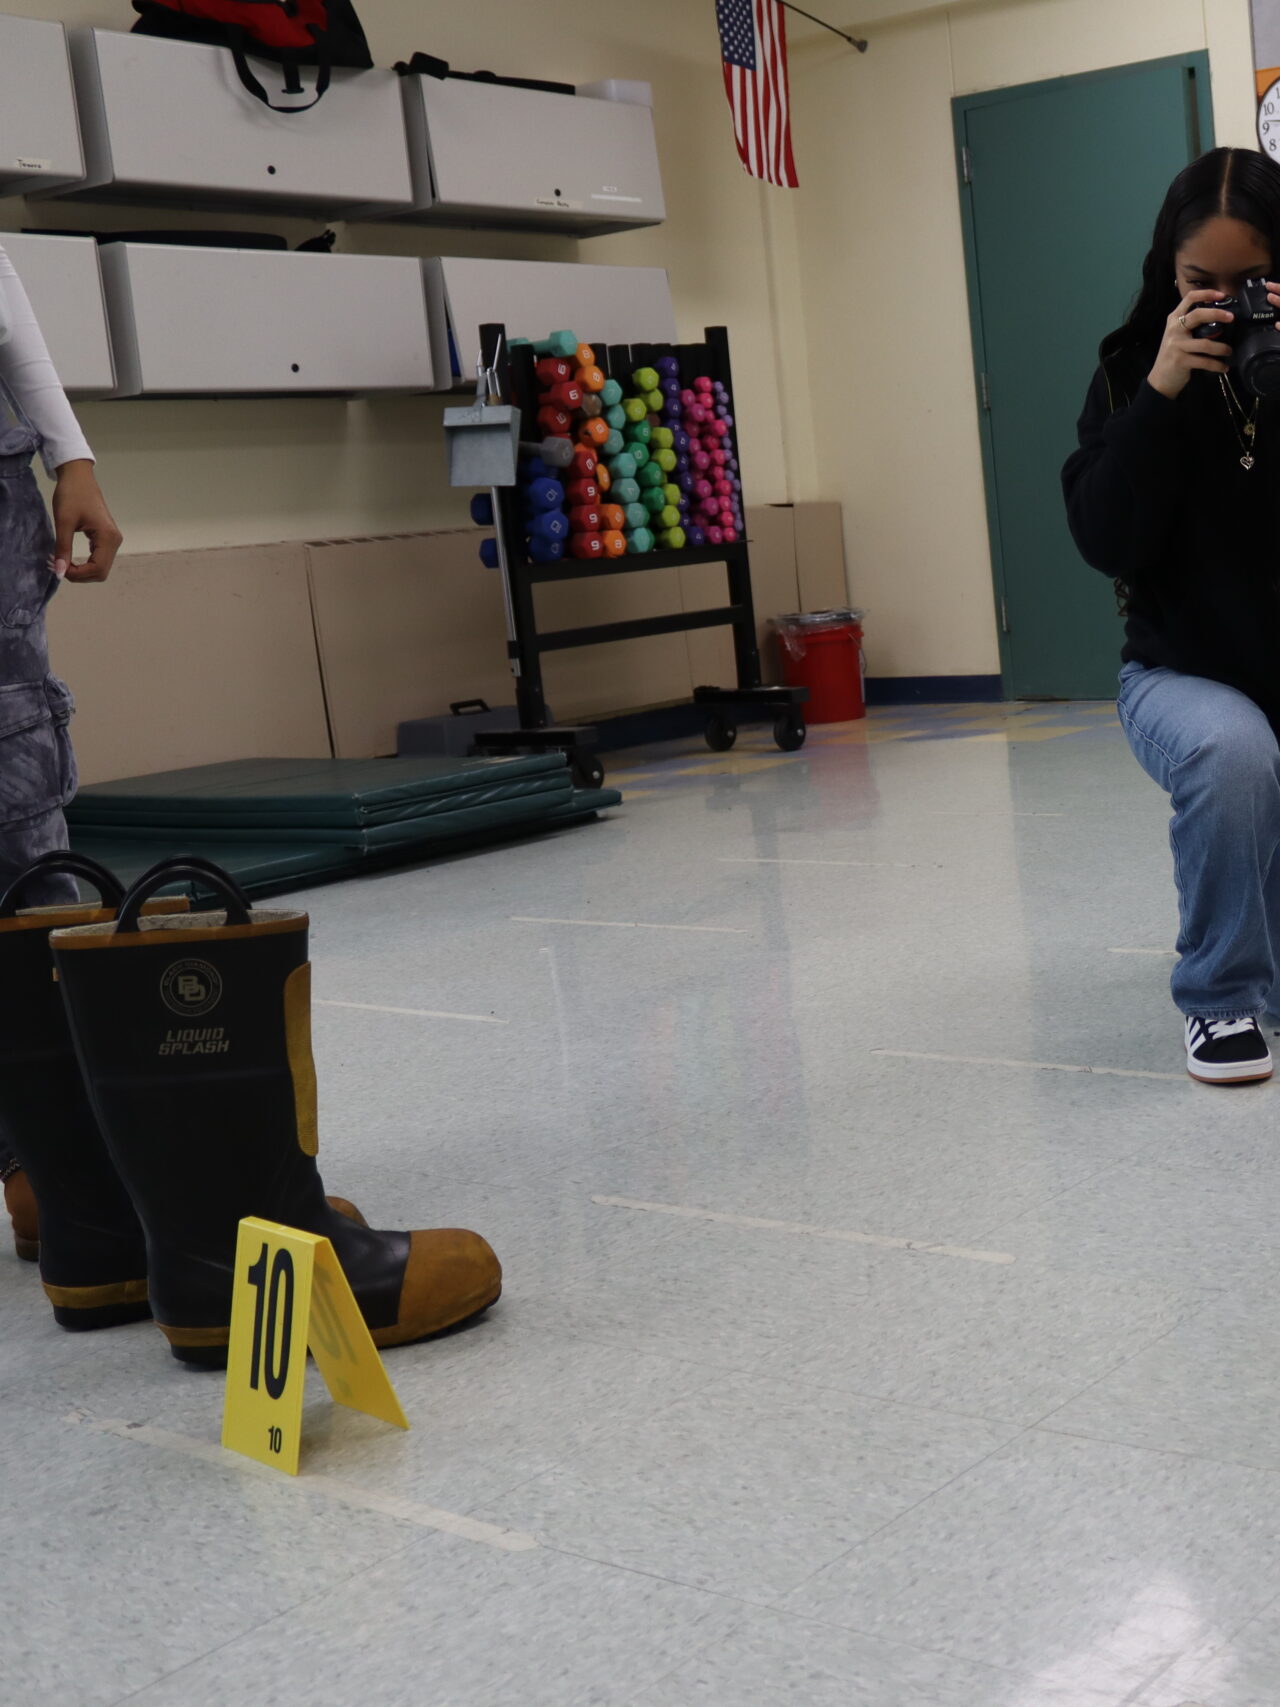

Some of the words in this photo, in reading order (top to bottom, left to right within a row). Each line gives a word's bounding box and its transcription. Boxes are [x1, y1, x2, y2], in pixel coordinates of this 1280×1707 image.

[1264, 102, 1275, 116] 10
[1262, 121, 1270, 134] 9
[1269, 139, 1277, 151] 8
[1252, 312, 1274, 320] Nikon
[166, 1028, 225, 1042] LIQUID
[158, 1040, 230, 1056] SPLASH
[248, 1242, 294, 1400] 10
[268, 1425, 282, 1454] 10
